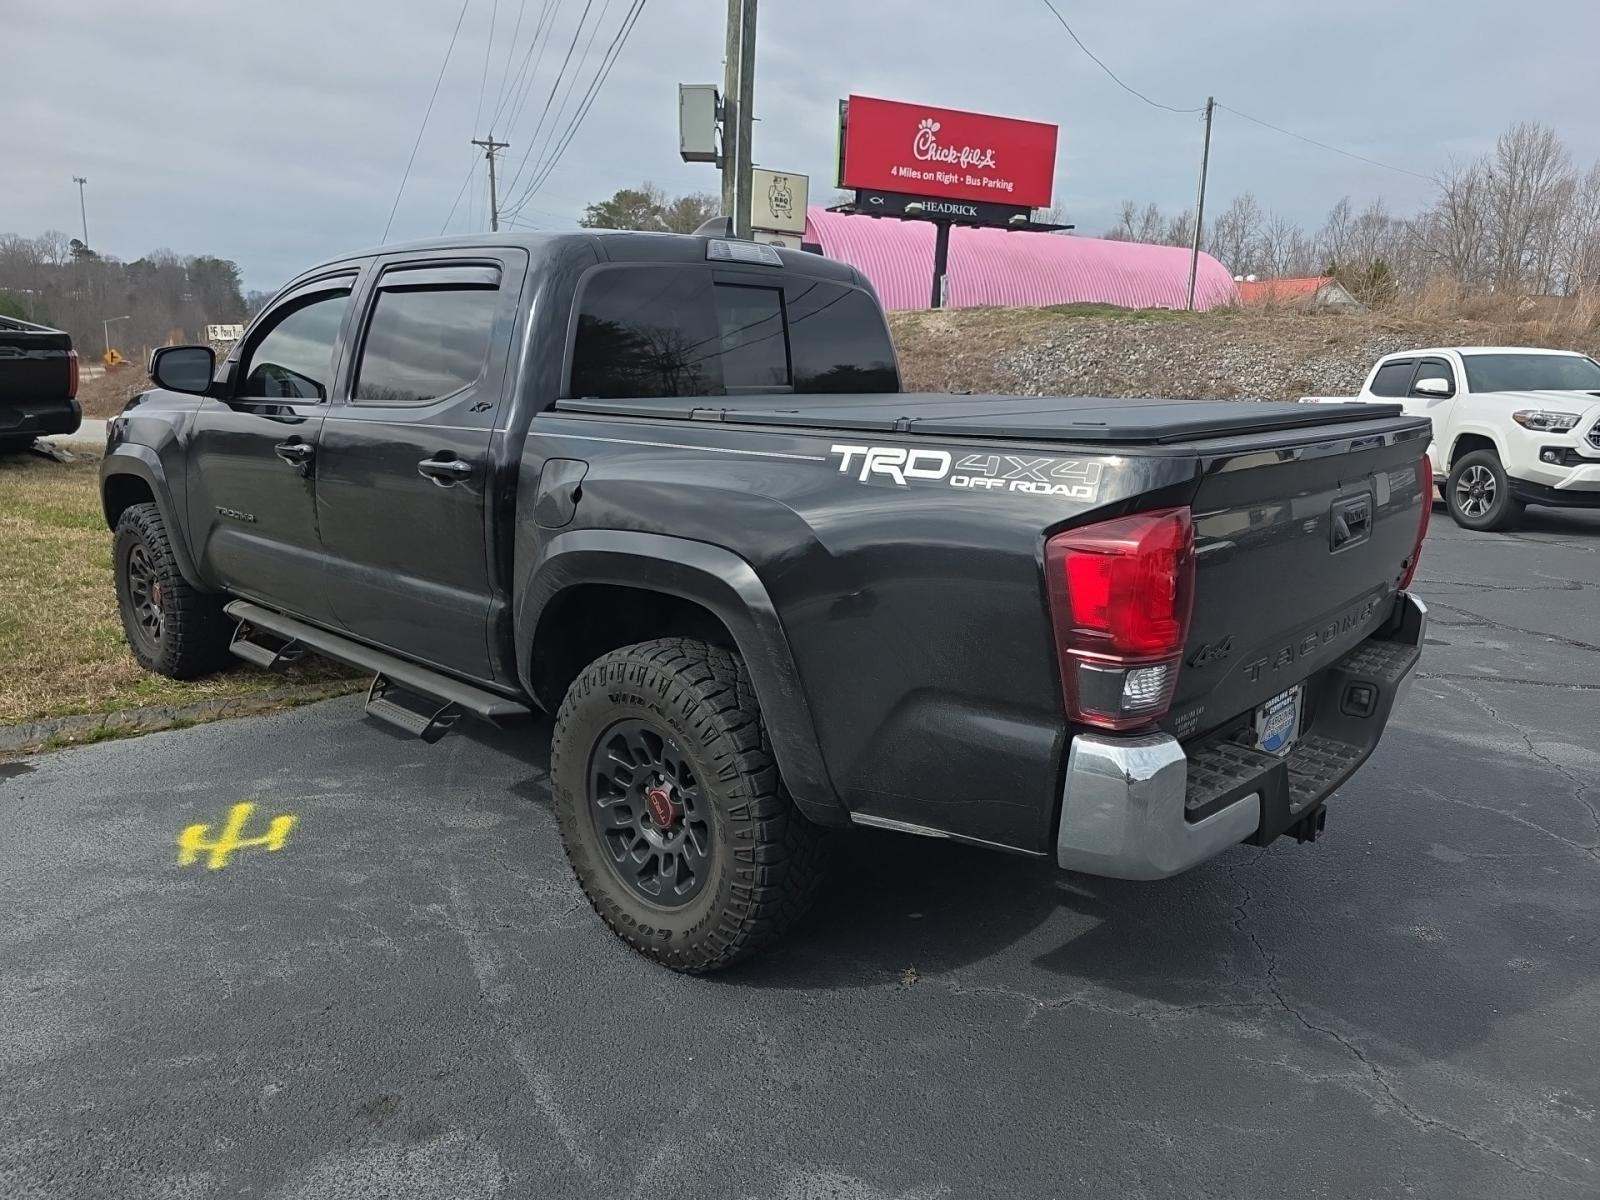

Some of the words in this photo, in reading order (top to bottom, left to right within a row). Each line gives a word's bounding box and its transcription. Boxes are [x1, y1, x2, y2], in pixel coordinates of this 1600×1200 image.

[913, 118, 996, 168] Chick-fil-A
[891, 166, 897, 176] 4
[899, 167, 921, 179] Miles
[923, 172, 934, 180] on
[936, 171, 958, 185] Right
[965, 175, 981, 186] Bus
[982, 177, 1013, 192] Parking
[922, 201, 978, 217] HEADRICK
[831, 444, 952, 485] TRD
[950, 475, 1006, 489] OFF
[1009, 480, 1093, 498] ROAD
[1242, 601, 1377, 682] TACOMA
